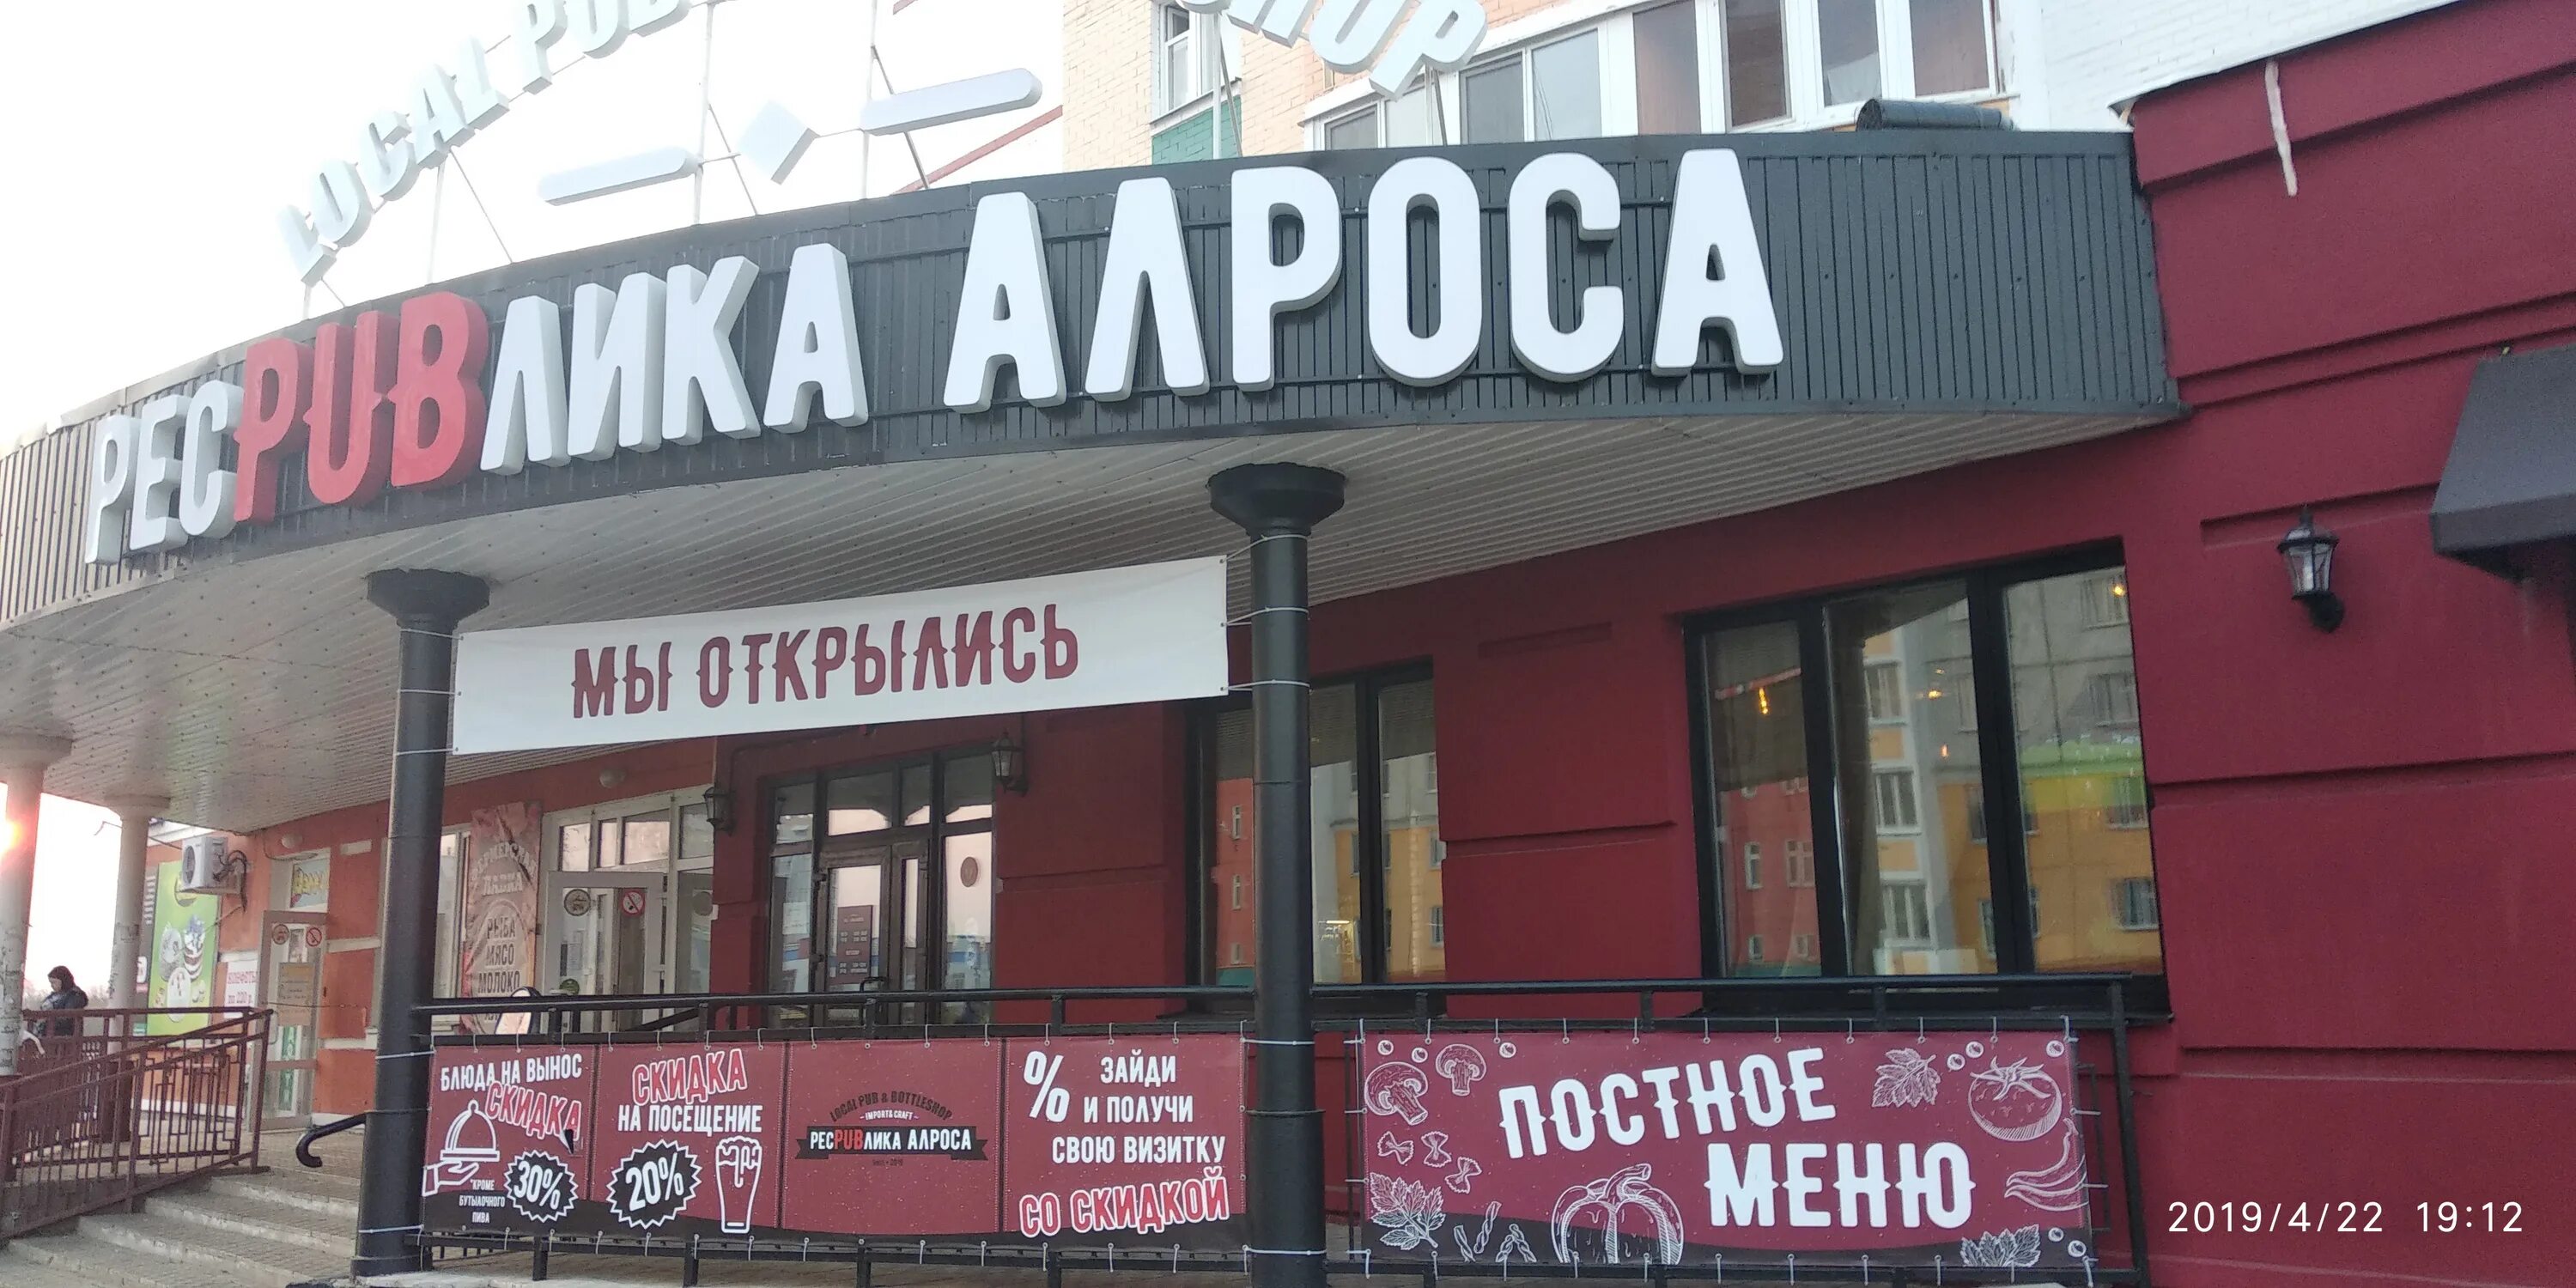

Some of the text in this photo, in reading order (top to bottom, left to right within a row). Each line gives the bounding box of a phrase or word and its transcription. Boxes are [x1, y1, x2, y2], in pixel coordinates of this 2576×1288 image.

[277, 34, 510, 286] LOCAL
[943, 148, 1783, 414] АЛРОСА
[570, 603, 1078, 719] МЫ ОТКРЫЛИСЬ
[487, 918, 515, 939] РЫБА
[485, 943, 515, 967] МЯСО
[477, 970, 521, 993] МОЛОКО
[440, 1054, 582, 1091] БЛЮДА НА ВЫНОС
[632, 1048, 748, 1106] СКИДКА
[1100, 1049, 1176, 1088] ЗАЙДИ
[484, 1081, 582, 1140] СКИДКА
[618, 1104, 763, 1136] НА ПОСЕЩЕНИЕ
[829, 1091, 952, 1122] LOCAL PUB & BOTTLESHOP
[1084, 1095, 1194, 1123] И ПОЛУЧИ
[1498, 1046, 1836, 1159] ПОСТНОЕ
[908, 1128, 972, 1151] АЛРОСА
[1052, 1135, 1225, 1164] СВОЮ ВИЗИТКУ
[459, 1194, 506, 1208] БУТЫЛОЧНОГО
[513, 1160, 562, 1211] 30%
[625, 1156, 684, 1212] 20%
[1019, 1165, 1230, 1238] СО СКИДКОЙ
[1704, 1141, 1978, 1229] МЕНЮ
[471, 1212, 490, 1224] ПИВА
